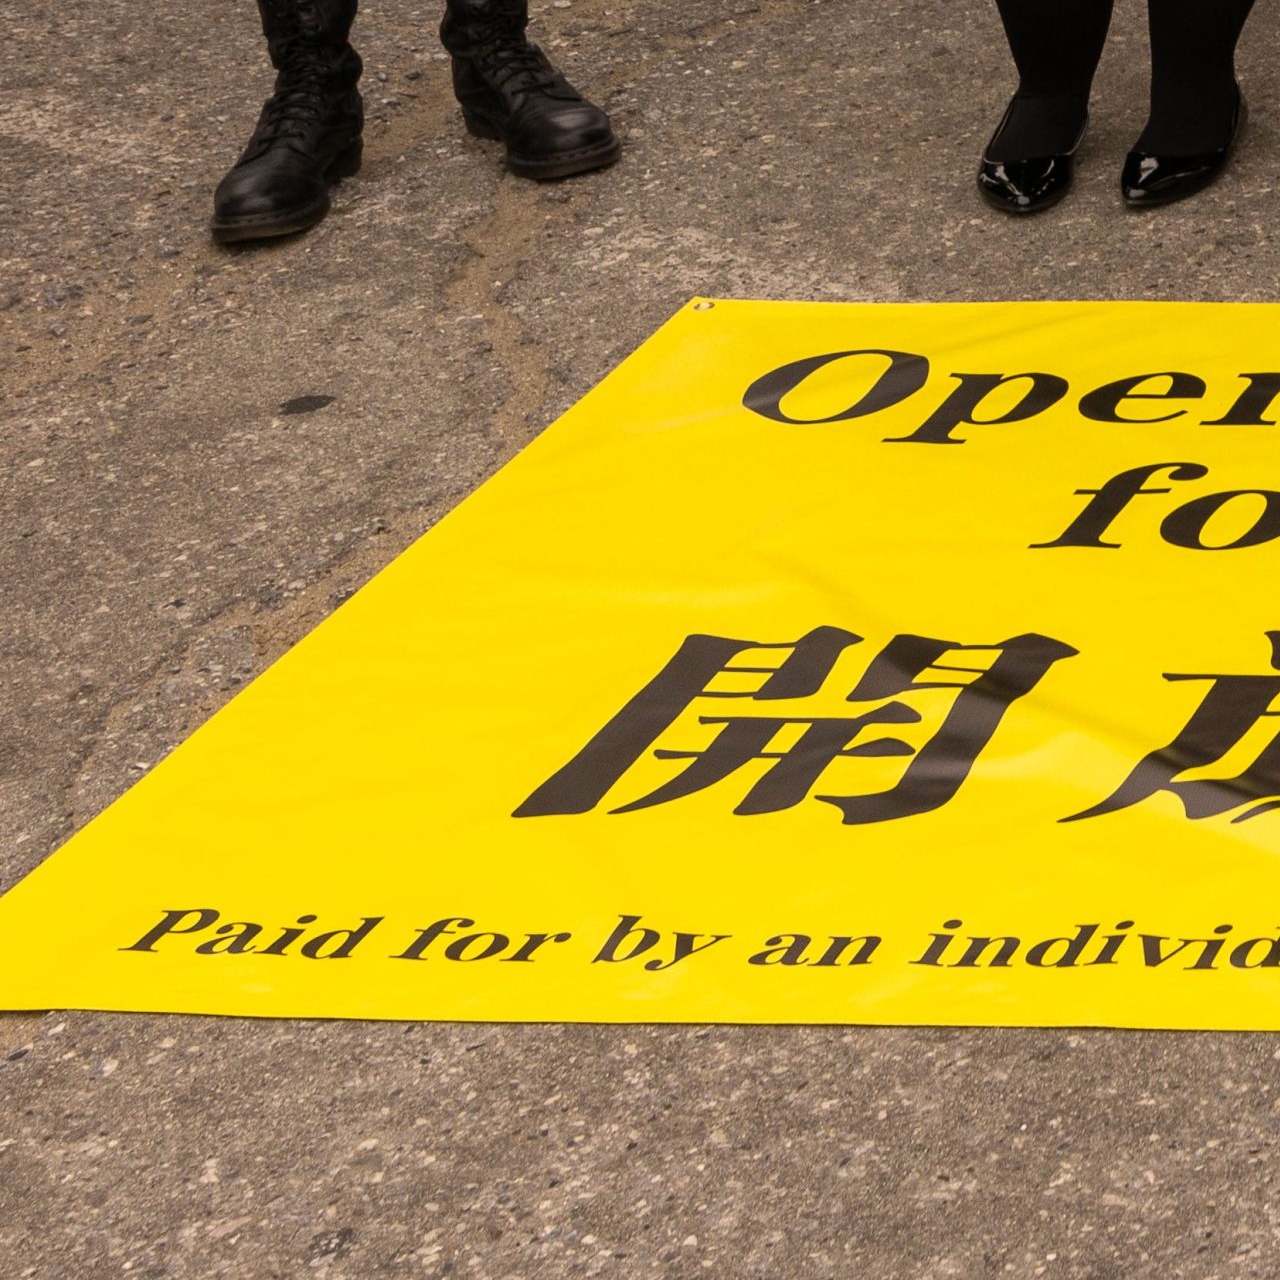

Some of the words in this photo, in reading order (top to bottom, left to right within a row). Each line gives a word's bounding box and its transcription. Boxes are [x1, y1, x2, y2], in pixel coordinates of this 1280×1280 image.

[118, 909, 384, 959] Paid
[390, 918, 571, 962] for
[592, 915, 732, 971] by
[754, 934, 881, 966] an
